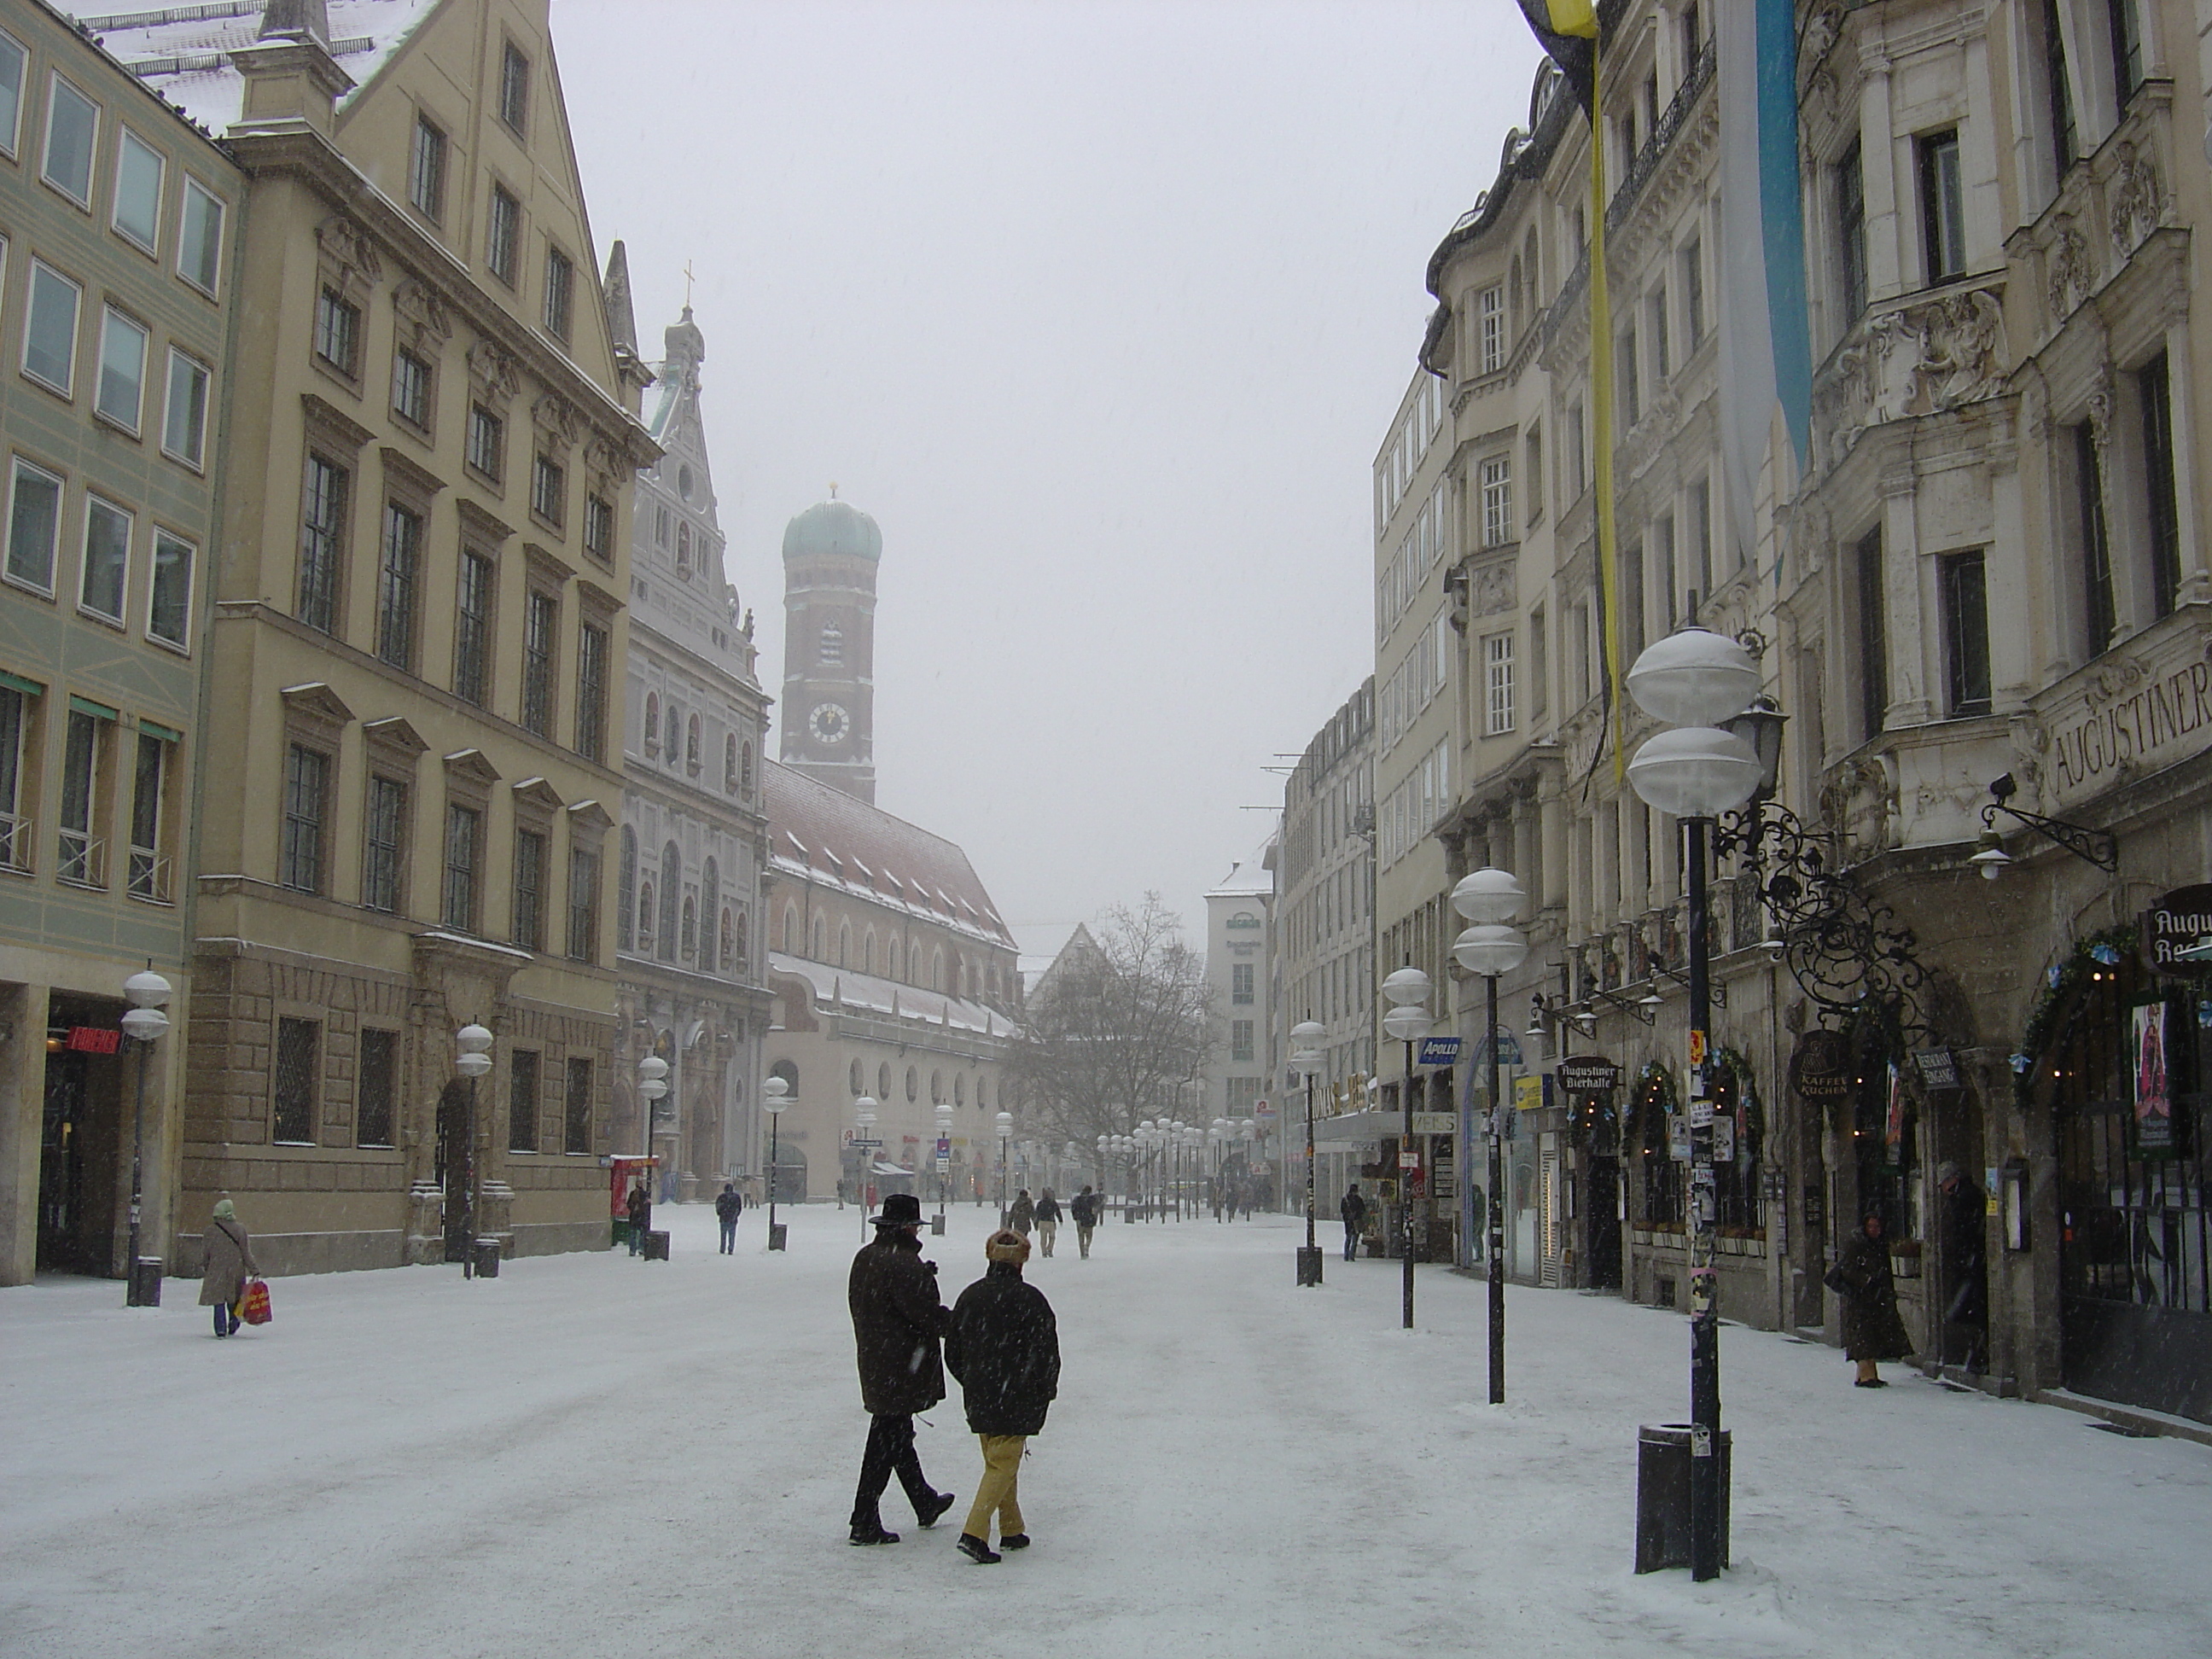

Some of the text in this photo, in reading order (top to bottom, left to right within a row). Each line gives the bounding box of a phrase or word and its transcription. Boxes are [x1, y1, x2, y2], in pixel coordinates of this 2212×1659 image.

[2055, 661, 2212, 795] AUGUSTINER
[1423, 1041, 1458, 1055] APOLLO
[1562, 1065, 1615, 1077] Augustiner
[1566, 1077, 1610, 1088] Bierhalle
[1802, 1074, 1848, 1086] KAFFEE
[1802, 1085, 1848, 1096] KUCHEN
